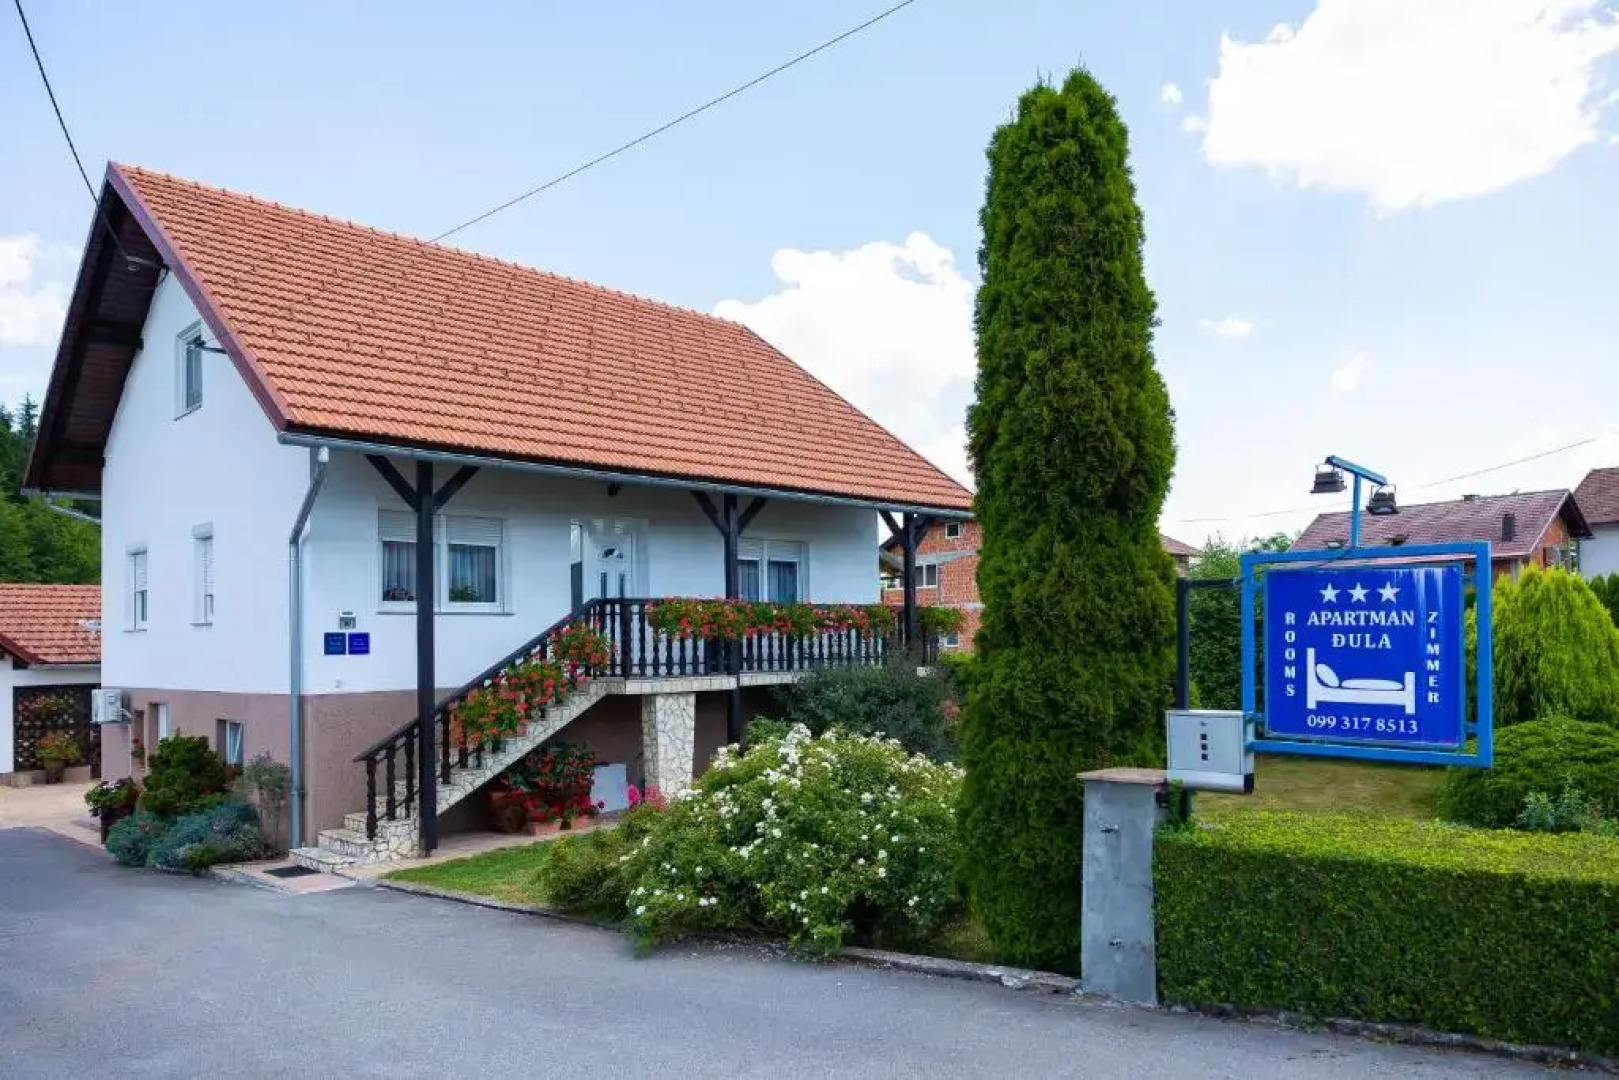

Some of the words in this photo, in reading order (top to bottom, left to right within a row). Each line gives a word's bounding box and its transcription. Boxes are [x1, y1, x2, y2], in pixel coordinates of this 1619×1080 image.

[1307, 611, 1415, 626] APARTMAN
[1332, 633, 1392, 649] ĐULA
[1285, 612, 1296, 697] ROOMS
[1426, 611, 1440, 703] ZIMMER
[1307, 715, 1337, 728] 099
[1341, 717, 1370, 730] 317
[1376, 718, 1418, 734] 8513
